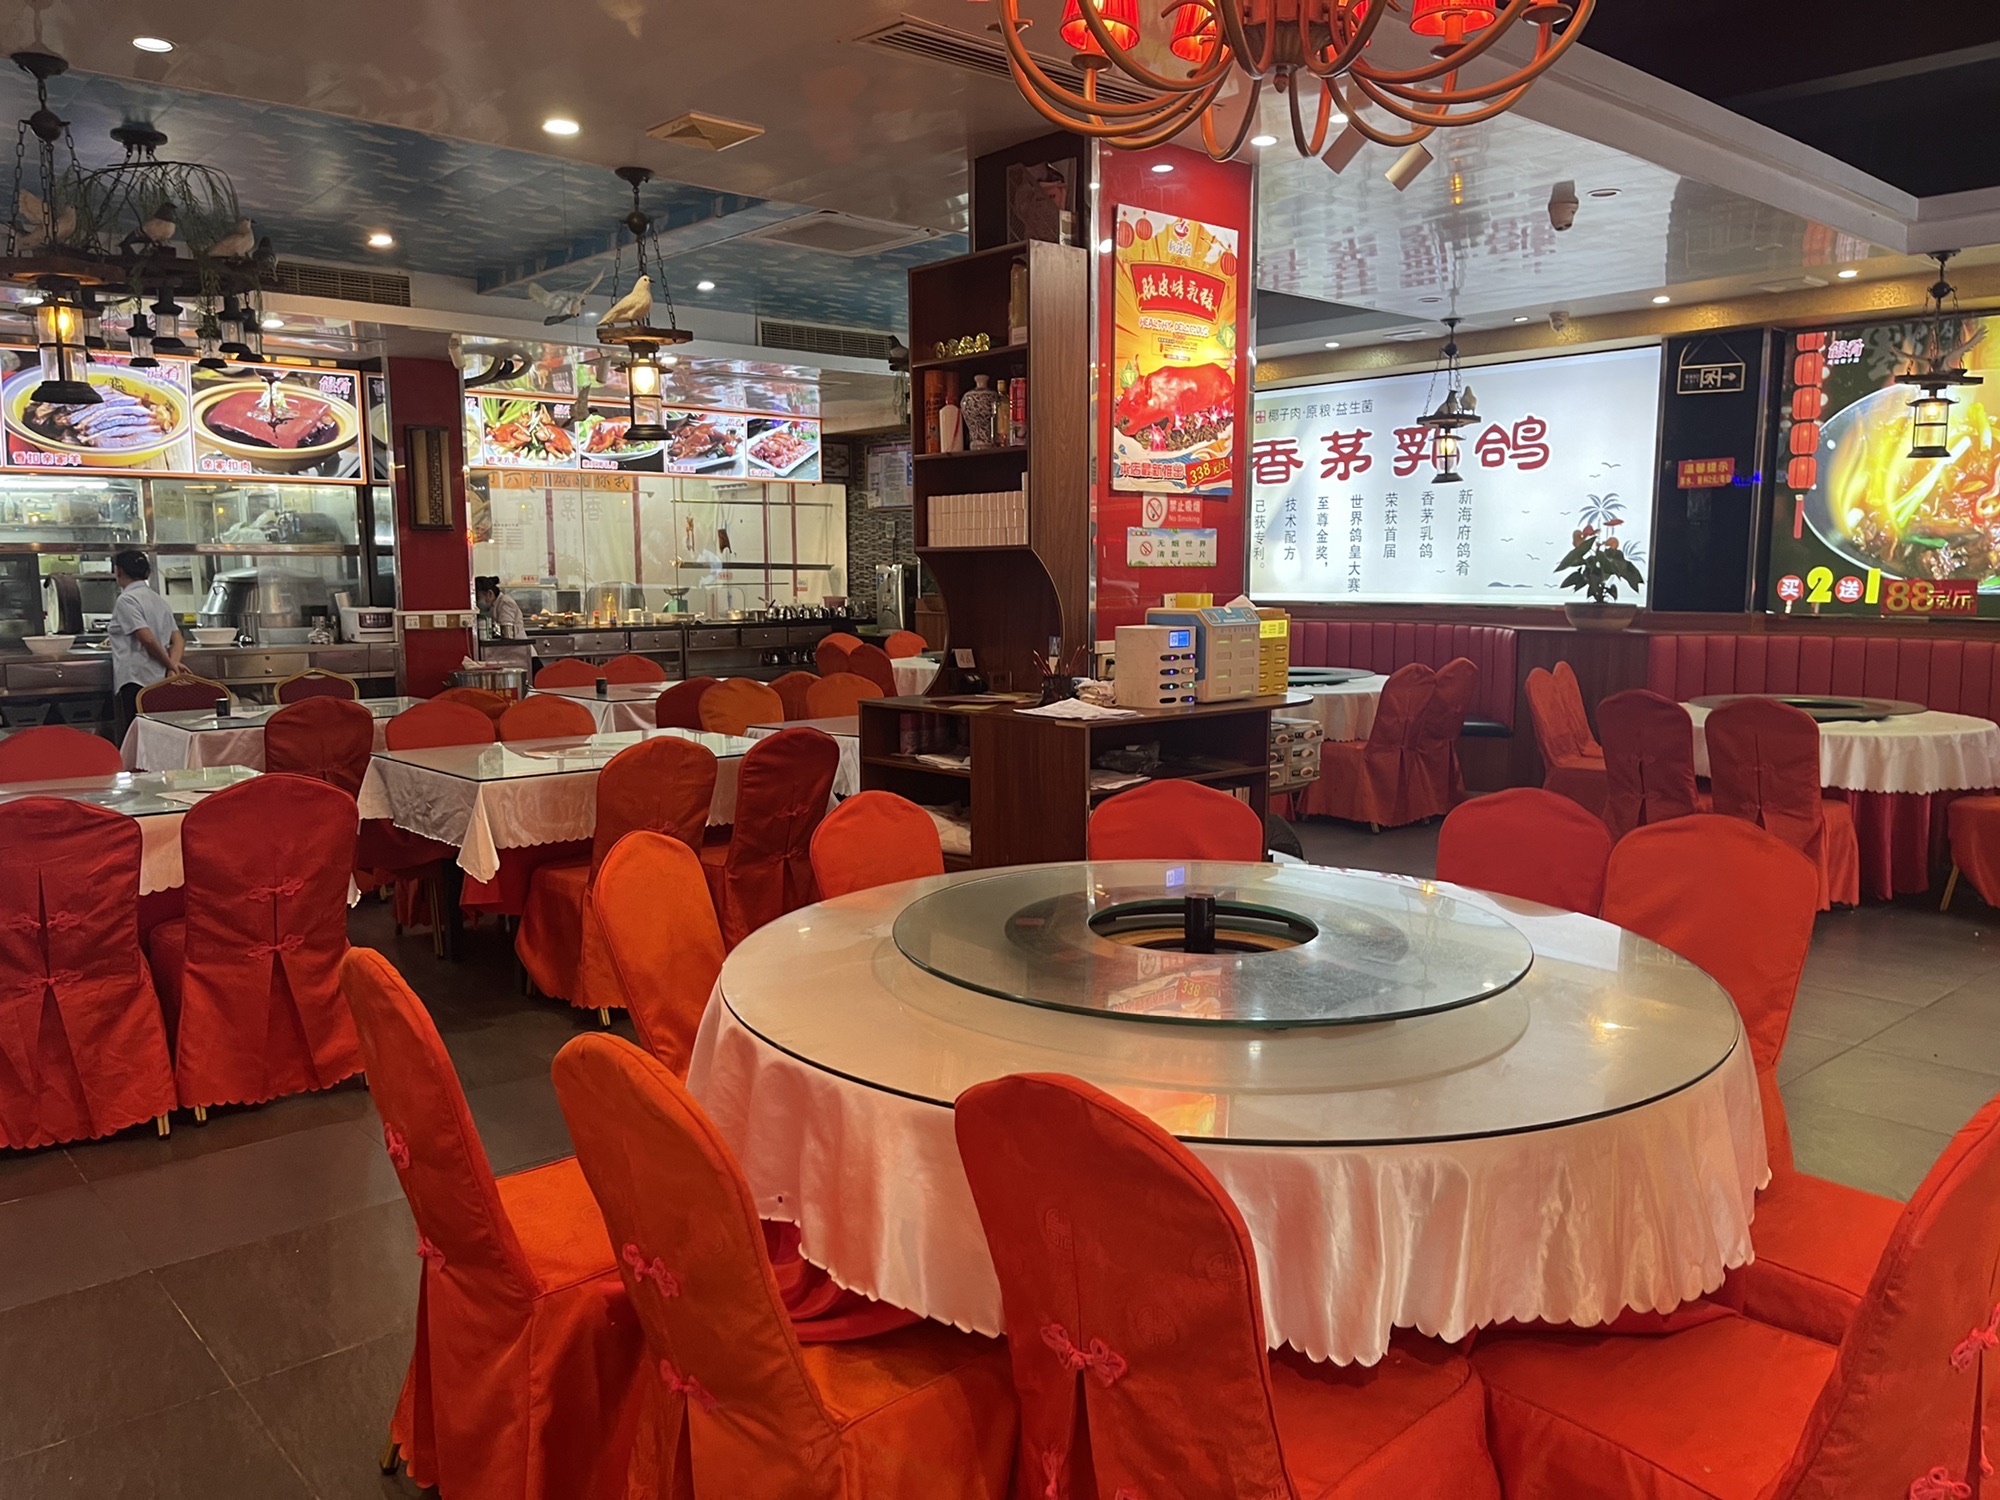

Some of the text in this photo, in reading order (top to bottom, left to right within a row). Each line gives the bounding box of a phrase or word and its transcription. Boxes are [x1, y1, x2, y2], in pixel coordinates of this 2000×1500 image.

[1268, 399, 1373, 422] 椰子肉·原粮·益生菌
[1253, 415, 1550, 485] 香茅乳鸽
[1120, 461, 1185, 479] 本店最新推出
[1168, 514, 1200, 524] No Smoking
[1169, 499, 1200, 513] 禁止吸烟
[1419, 491, 1435, 558] 香茅乳鸽
[1157, 539, 1206, 548] 无烟世界
[1284, 497, 1297, 560] 技术配方
[1347, 494, 1363, 593] 世界鸽皇大赛
[1383, 492, 1398, 559] 荣获首届
[1456, 489, 1473, 576] 新海府鸽肴
[1157, 550, 1206, 558] 清新一片
[1780, 566, 1881, 604] 买2送1
